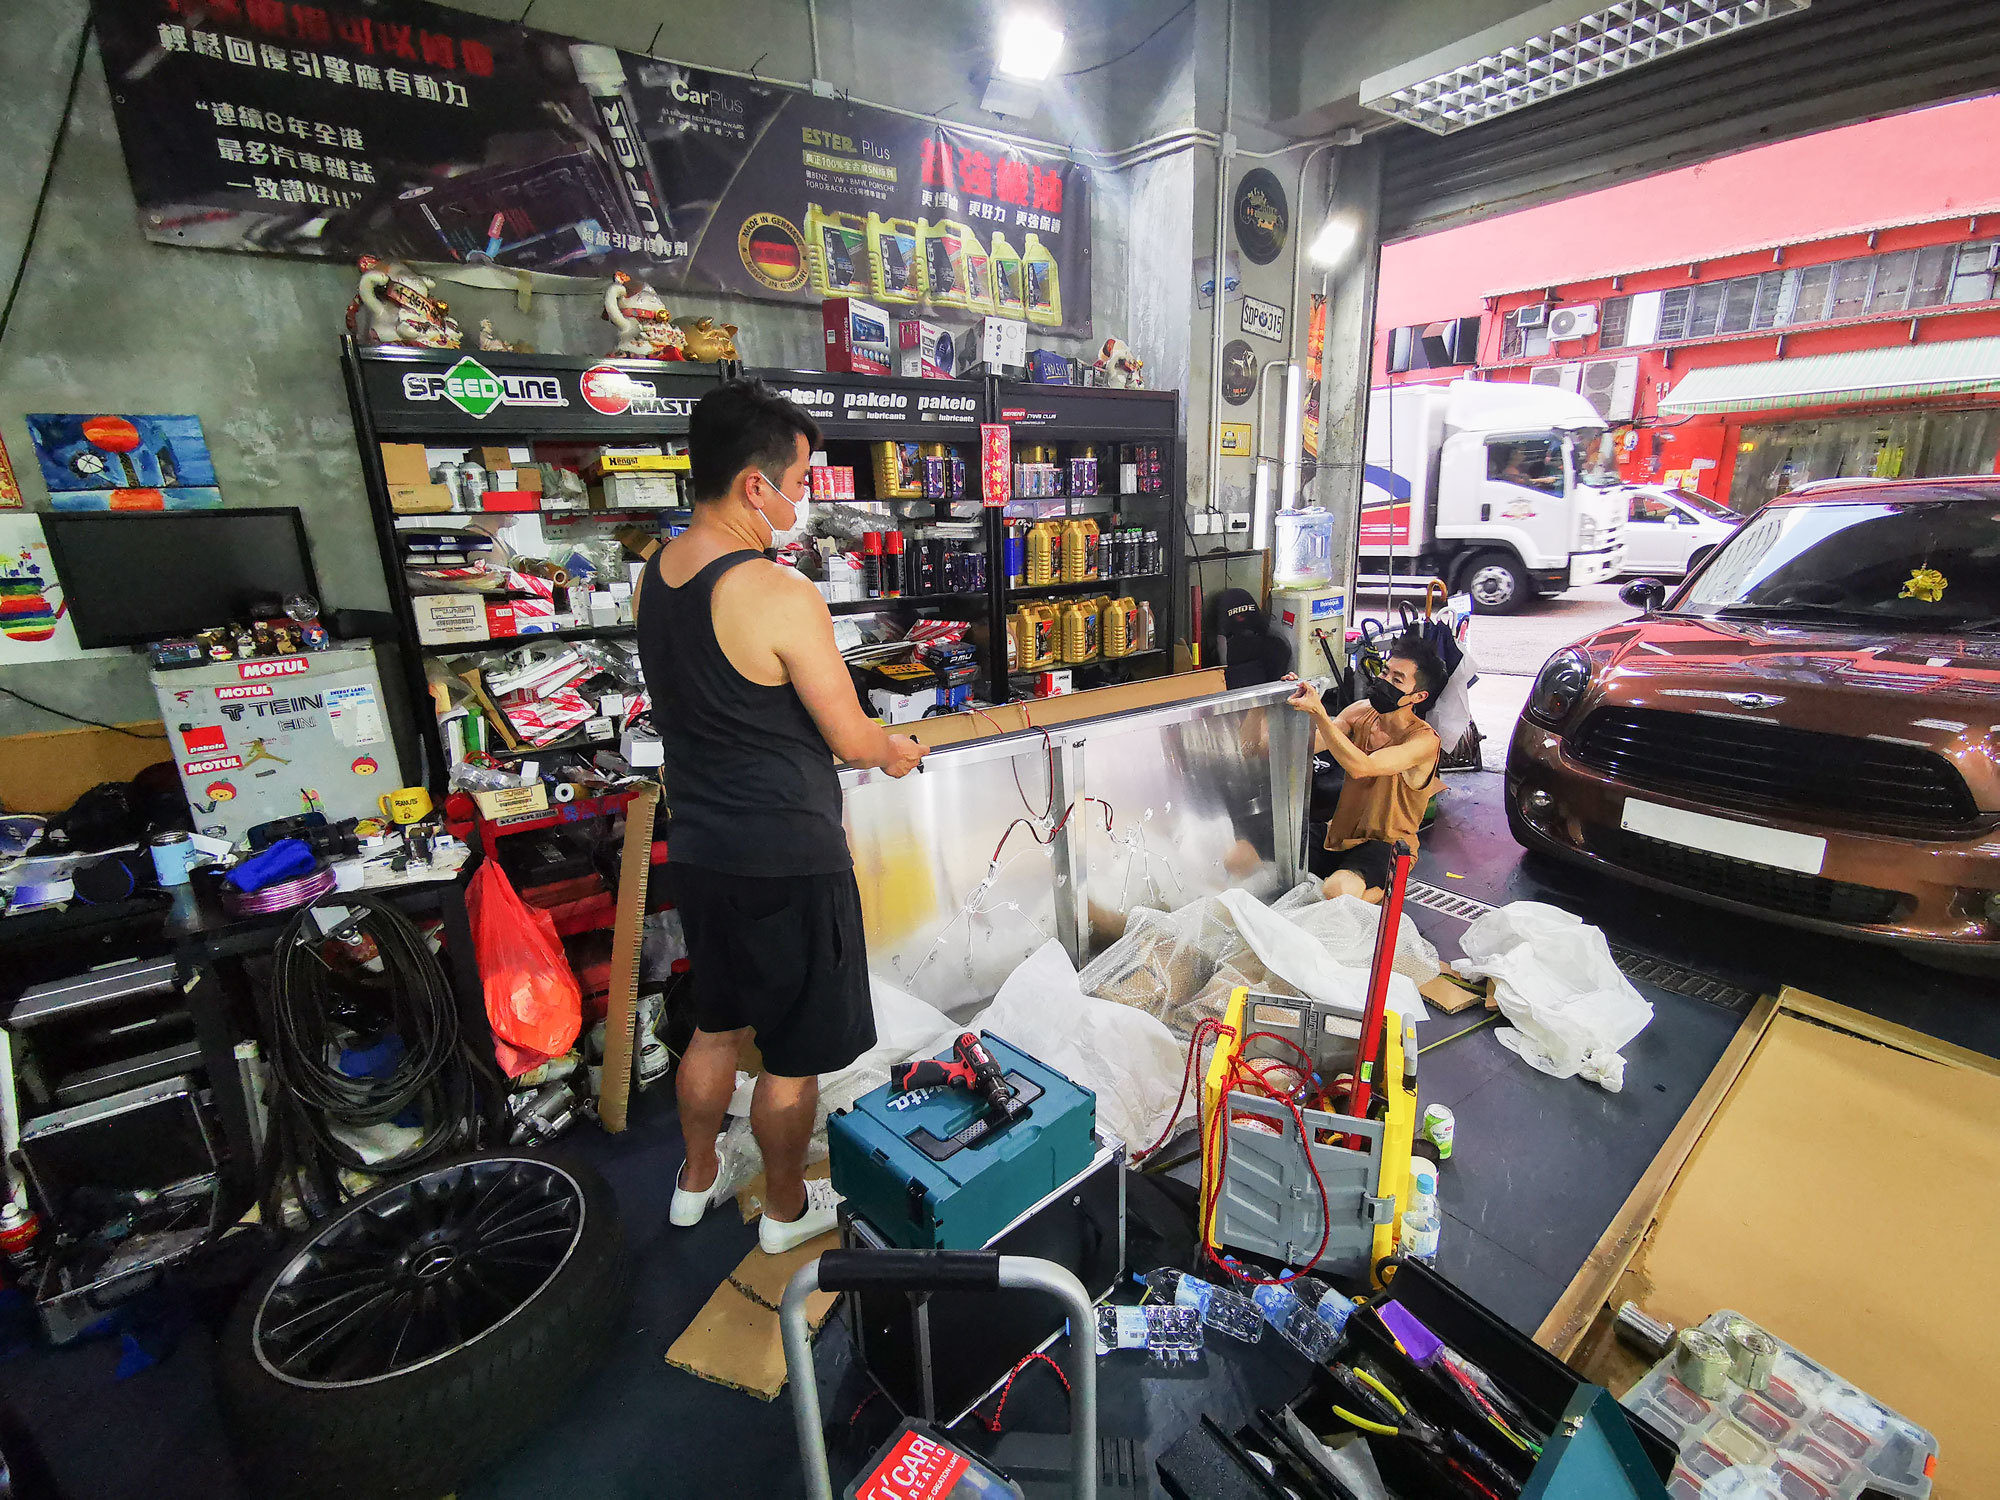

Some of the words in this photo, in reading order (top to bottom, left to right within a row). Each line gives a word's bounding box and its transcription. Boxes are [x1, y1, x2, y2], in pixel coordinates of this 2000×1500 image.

[862, 139, 891, 161] Plus
[968, 200, 1006, 223] 更好力
[1015, 210, 1062, 234] 更強保護
[742, 218, 759, 238] MADE
[759, 215, 769, 224] IN
[746, 261, 767, 284] MADE
[1244, 304, 1259, 326] SDP
[1267, 312, 1282, 334] 315
[1043, 362, 1068, 377] ENDLESS
[409, 376, 558, 400] SPEEDLINE
[843, 392, 908, 408] pakelo
[917, 395, 976, 411] pakelo
[866, 411, 907, 421] lubricants
[938, 413, 975, 423] lubricants
[609, 456, 639, 466] Hengst
[1227, 604, 1256, 617] BRIDE
[244, 660, 308, 678] MOTUL
[218, 684, 271, 699] MOTUL
[248, 694, 323, 717] TEIN
[190, 742, 225, 754] pakelo
[187, 757, 240, 774] MOTUL
[931, 1467, 952, 1495] CREATION
